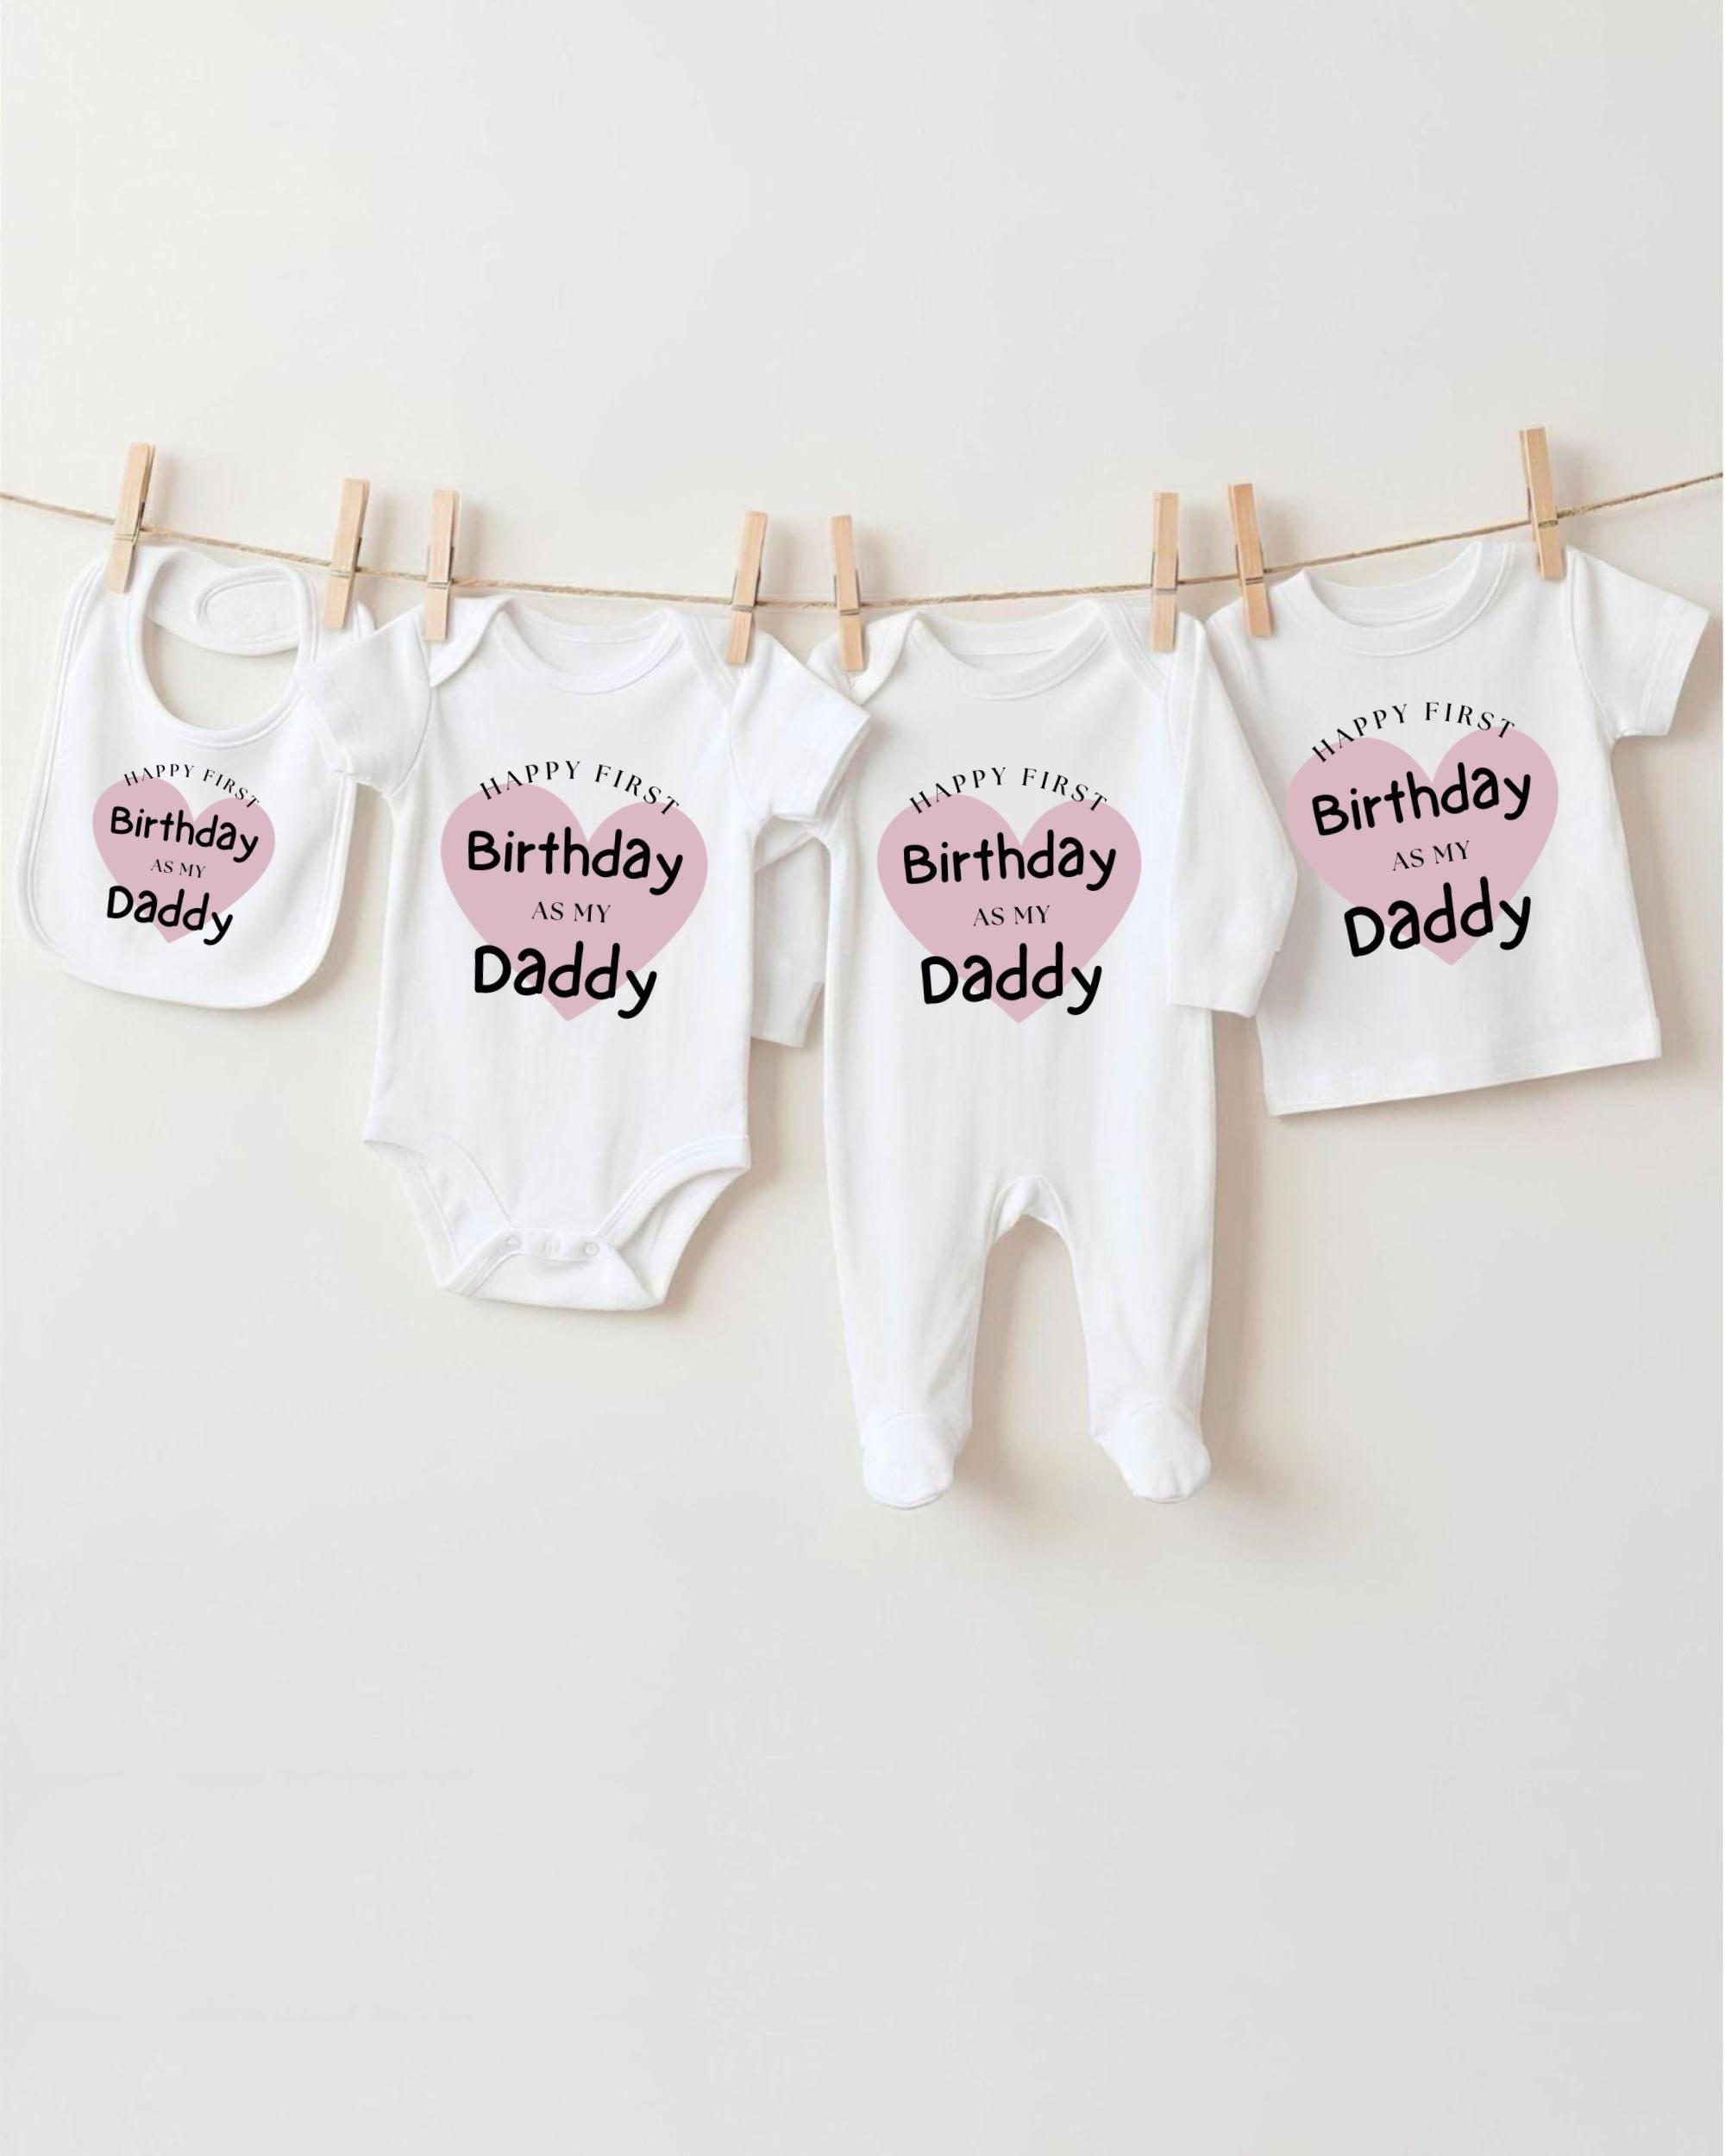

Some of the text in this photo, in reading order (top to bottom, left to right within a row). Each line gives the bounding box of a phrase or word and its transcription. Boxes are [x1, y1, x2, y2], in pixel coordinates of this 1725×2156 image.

[1312, 702, 1515, 762] HAPPY FIRST
[124, 764, 259, 807] HAPPY FIRST
[480, 761, 679, 814] HAPPY FIRST
[910, 768, 1107, 814] HAPPY FIRST
[1312, 762, 1531, 836] Birthday
[110, 806, 258, 862] Birthday
[468, 826, 683, 895] Birthday
[904, 830, 1116, 891] Birthday
[1393, 841, 1469, 871] AS MY
[151, 859, 205, 878] AS MY
[107, 886, 233, 945] Daddy
[531, 902, 611, 923] AS MY
[974, 906, 1050, 926] AS MY
[1345, 876, 1531, 957] Daddy
[474, 941, 656, 1018] Daddy
[921, 942, 1101, 1015] Daddy
